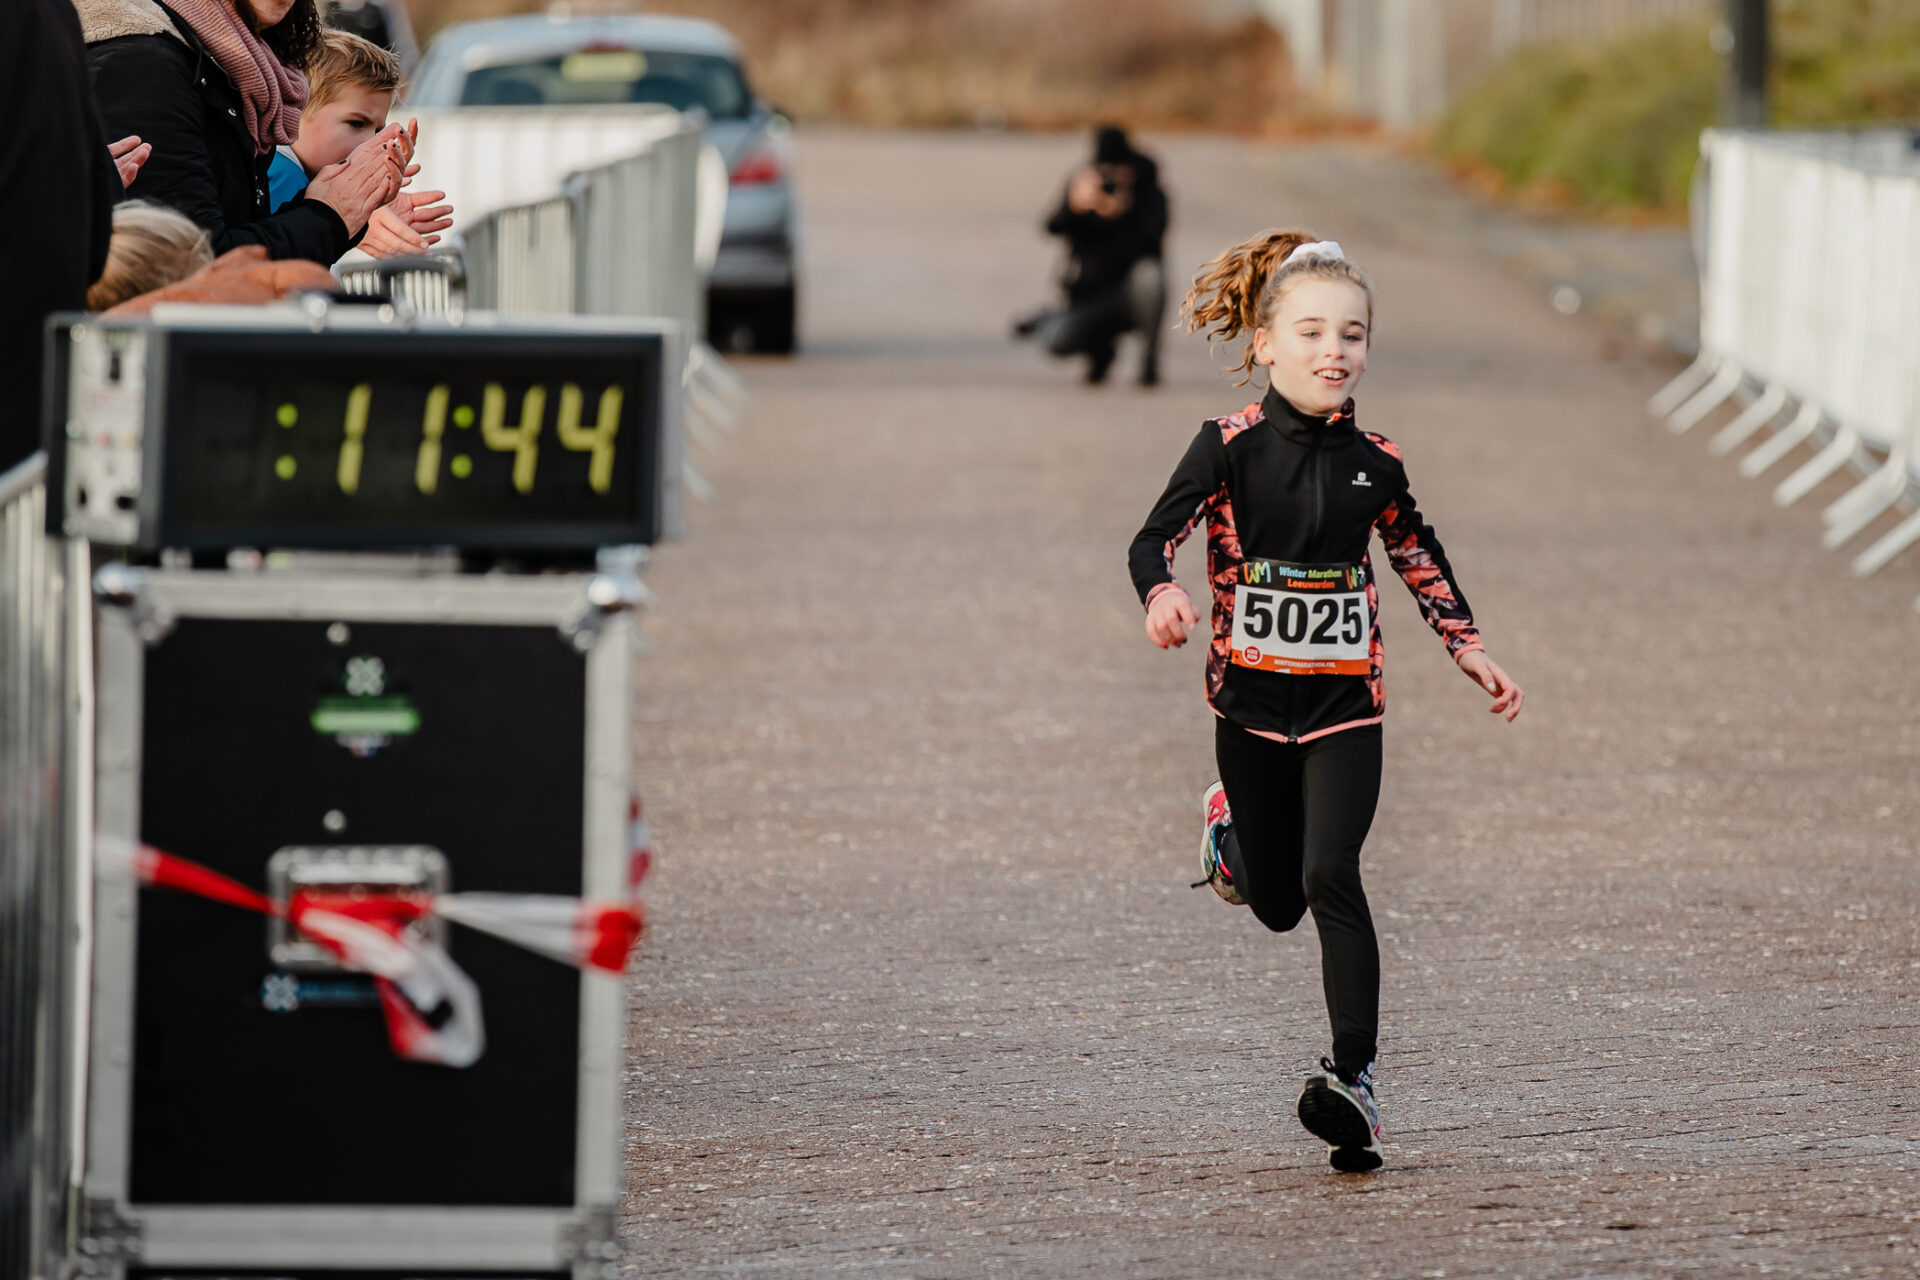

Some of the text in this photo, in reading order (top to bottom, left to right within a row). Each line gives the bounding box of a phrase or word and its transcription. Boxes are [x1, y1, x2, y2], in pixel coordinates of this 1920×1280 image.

[1279, 566, 1342, 579] Winter Marathon
[1287, 578, 1335, 589] Leeuwarden
[1243, 592, 1362, 645] 5025
